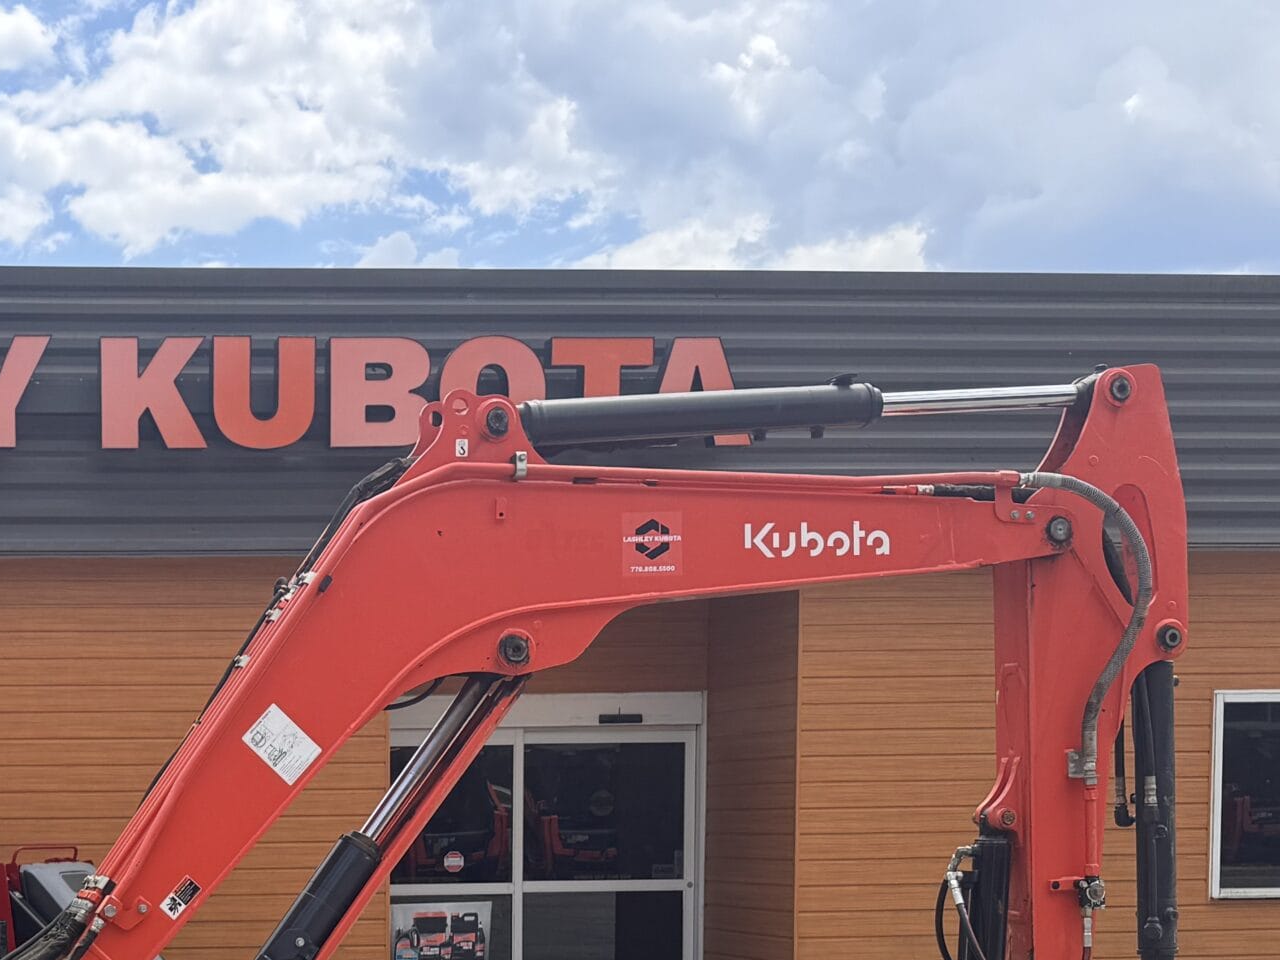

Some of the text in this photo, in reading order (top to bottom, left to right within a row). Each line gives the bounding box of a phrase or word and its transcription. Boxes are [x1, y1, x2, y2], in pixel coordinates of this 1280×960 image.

[100, 335, 753, 450] KUBOTA
[623, 535, 653, 543] LASHLEY
[744, 520, 890, 558] Kubota
